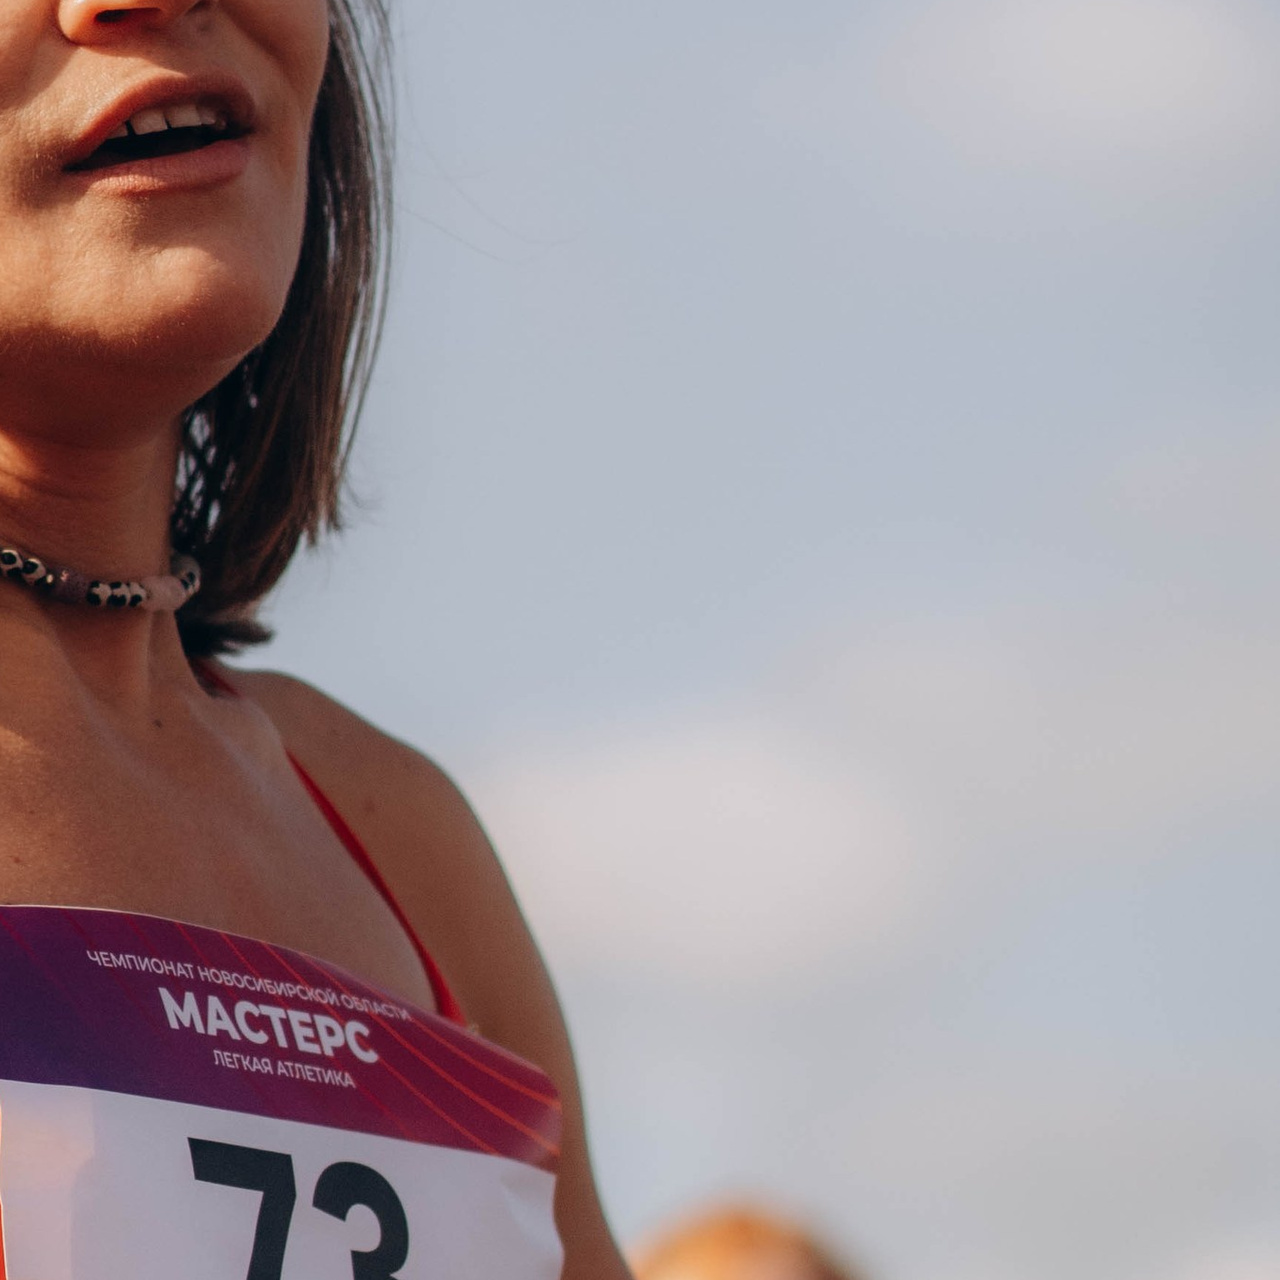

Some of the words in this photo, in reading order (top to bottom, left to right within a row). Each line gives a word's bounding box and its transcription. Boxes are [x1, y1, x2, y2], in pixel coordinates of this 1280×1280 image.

[86, 950, 194, 979] ЧЕМПИОНАТ
[197, 966, 340, 1006] НОВОСИБИРСКОЙ
[158, 987, 379, 1063] МАСТЕРС
[213, 1049, 272, 1074] ЛЕГКАЯ
[277, 1061, 356, 1088] АТЛЕТИКА
